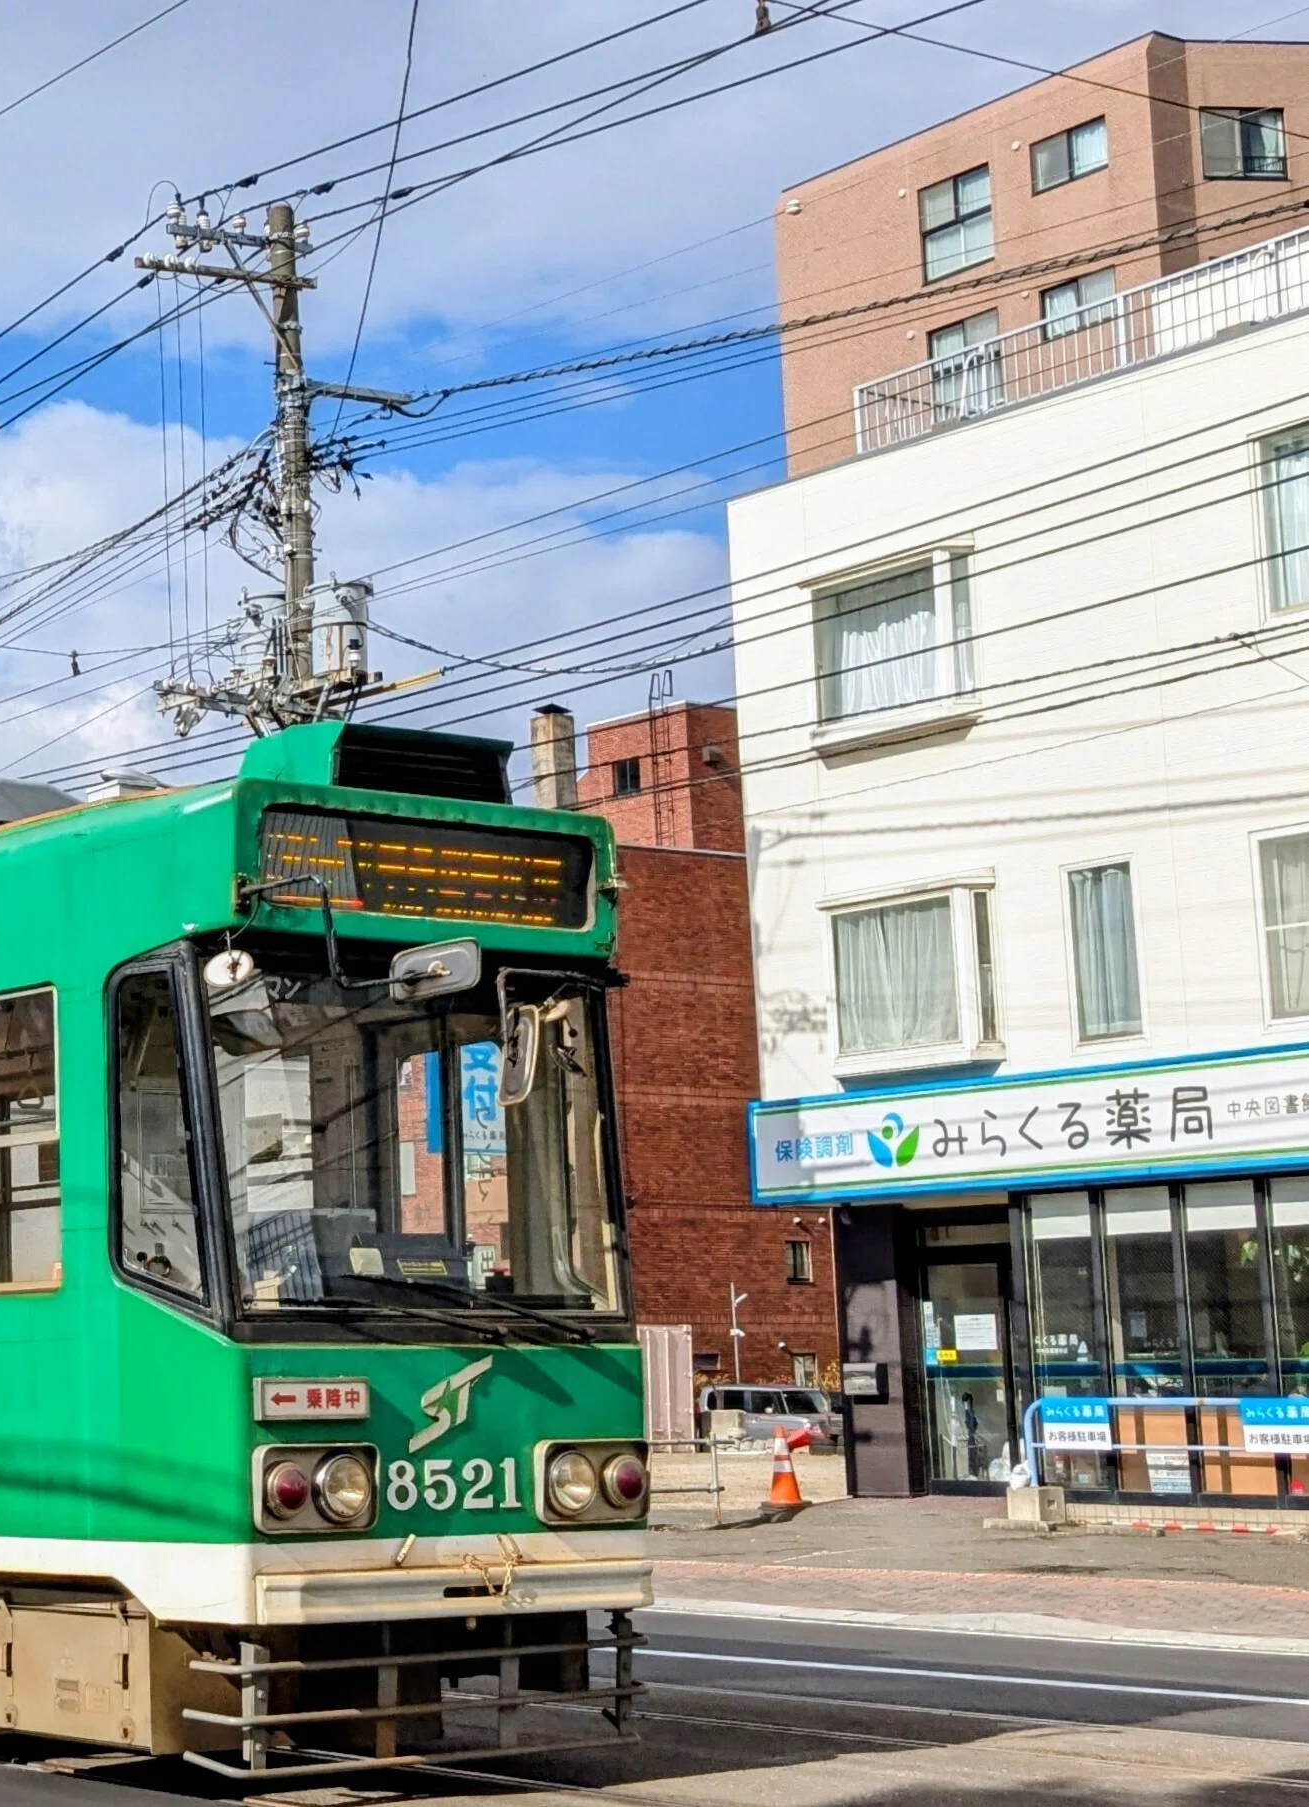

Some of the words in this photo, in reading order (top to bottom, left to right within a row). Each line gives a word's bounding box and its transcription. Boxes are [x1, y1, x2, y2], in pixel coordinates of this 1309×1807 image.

[932, 1086, 1213, 1157] みらくる薬局
[775, 1133, 854, 1162] 保険調剤
[307, 1387, 361, 1409] 乗降中
[1046, 1405, 1105, 1418] みらくる薬局
[1048, 1430, 1107, 1443] お客様駐車場
[386, 1457, 522, 1511] 8521
